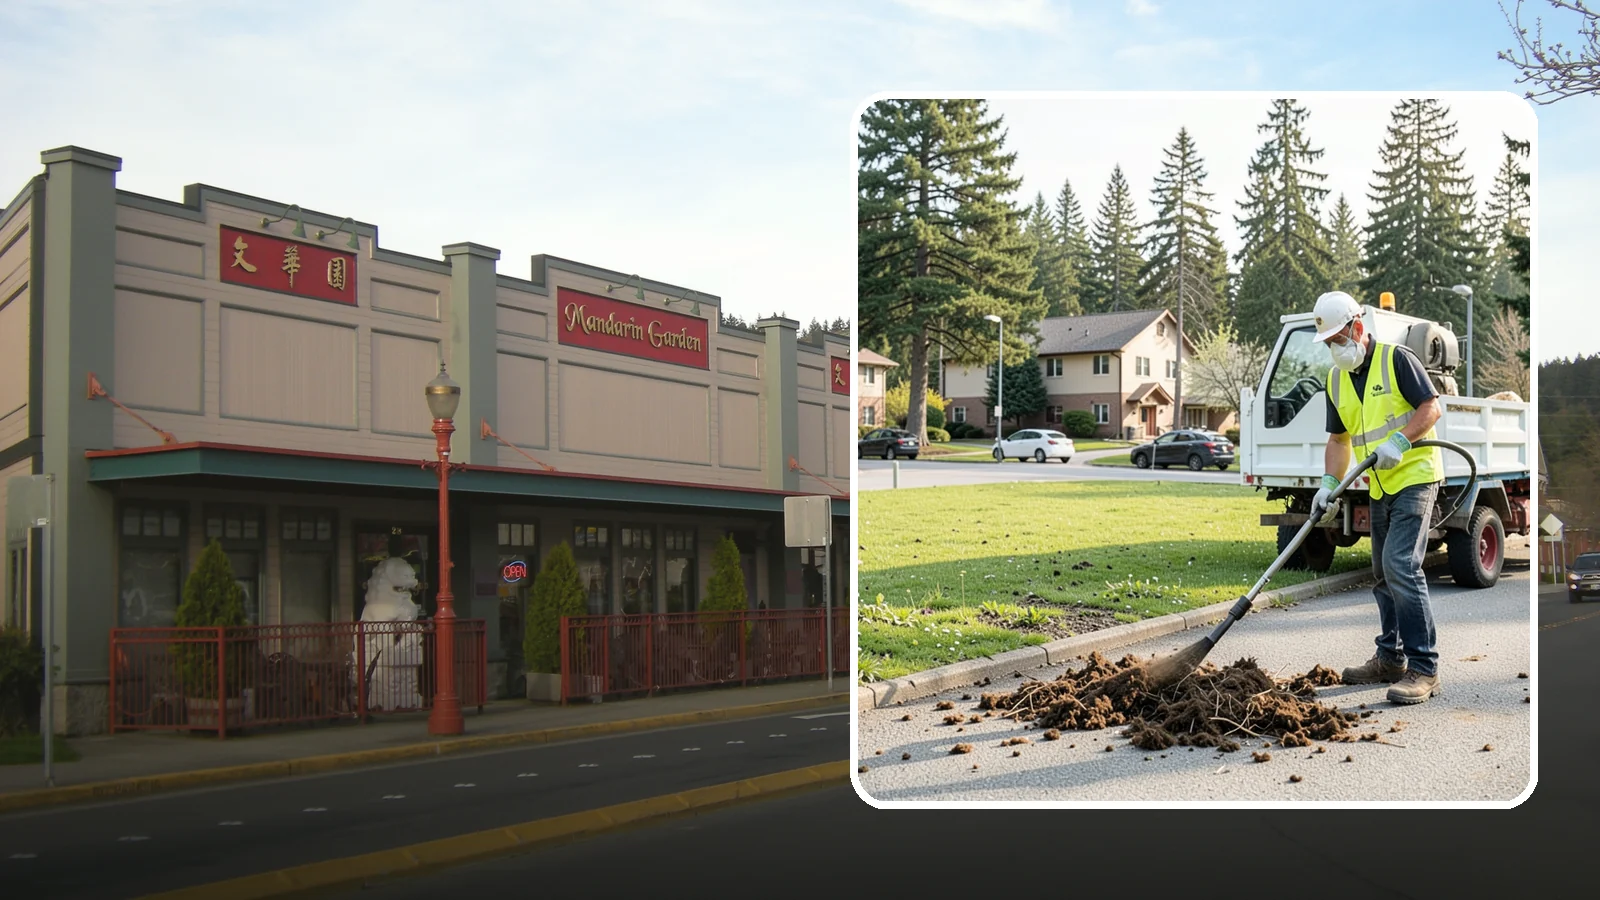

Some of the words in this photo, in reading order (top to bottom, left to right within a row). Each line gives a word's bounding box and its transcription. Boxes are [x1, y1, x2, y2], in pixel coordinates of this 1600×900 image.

[230, 236, 346, 290] 文華園
[564, 302, 644, 340] Mandarin
[647, 320, 701, 352] Garden
[835, 363, 847, 386] 文
[503, 565, 527, 578] OPEN
